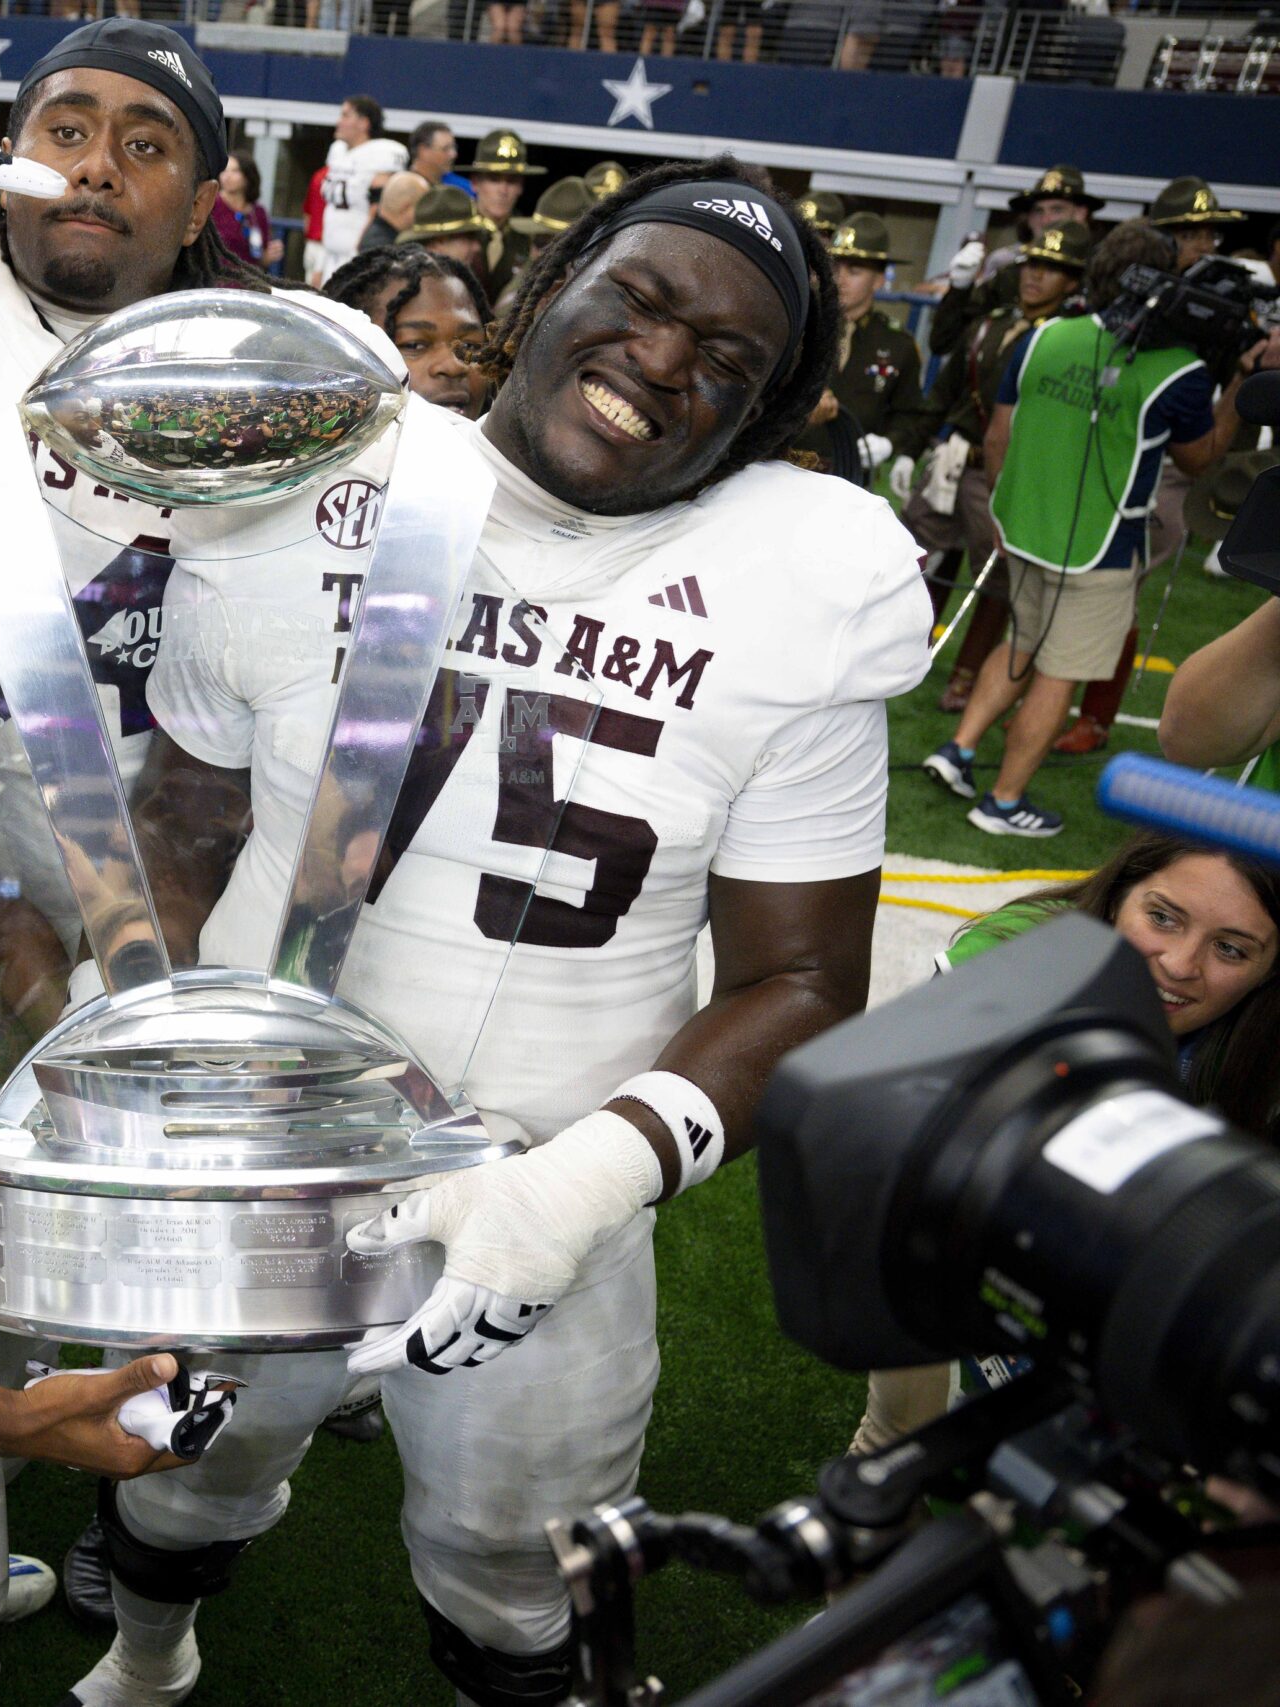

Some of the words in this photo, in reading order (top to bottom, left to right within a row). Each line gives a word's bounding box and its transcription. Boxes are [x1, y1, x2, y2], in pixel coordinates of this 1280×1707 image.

[148, 51, 192, 88] adidas
[693, 201, 782, 251] adidas
[553, 614, 713, 710] A&M
